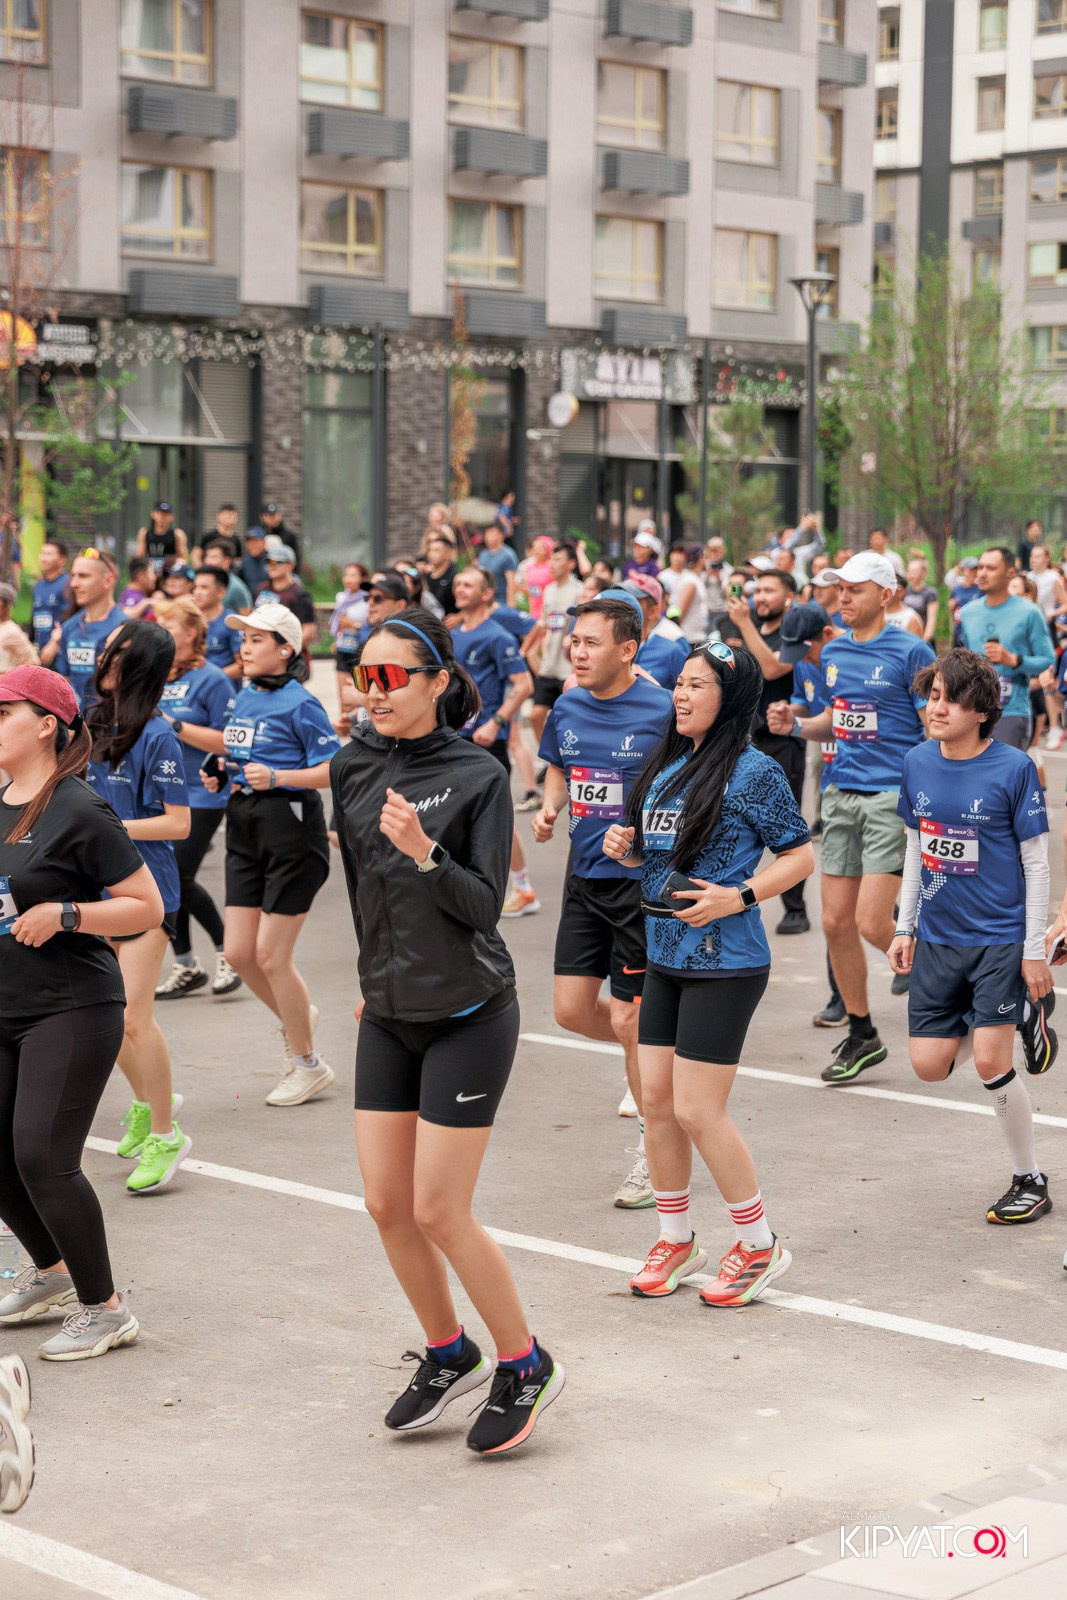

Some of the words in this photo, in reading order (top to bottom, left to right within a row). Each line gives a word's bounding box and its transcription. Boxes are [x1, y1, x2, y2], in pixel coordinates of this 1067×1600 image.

[839, 713, 866, 728] 362
[577, 784, 608, 803] 164
[927, 838, 966, 859] 458
